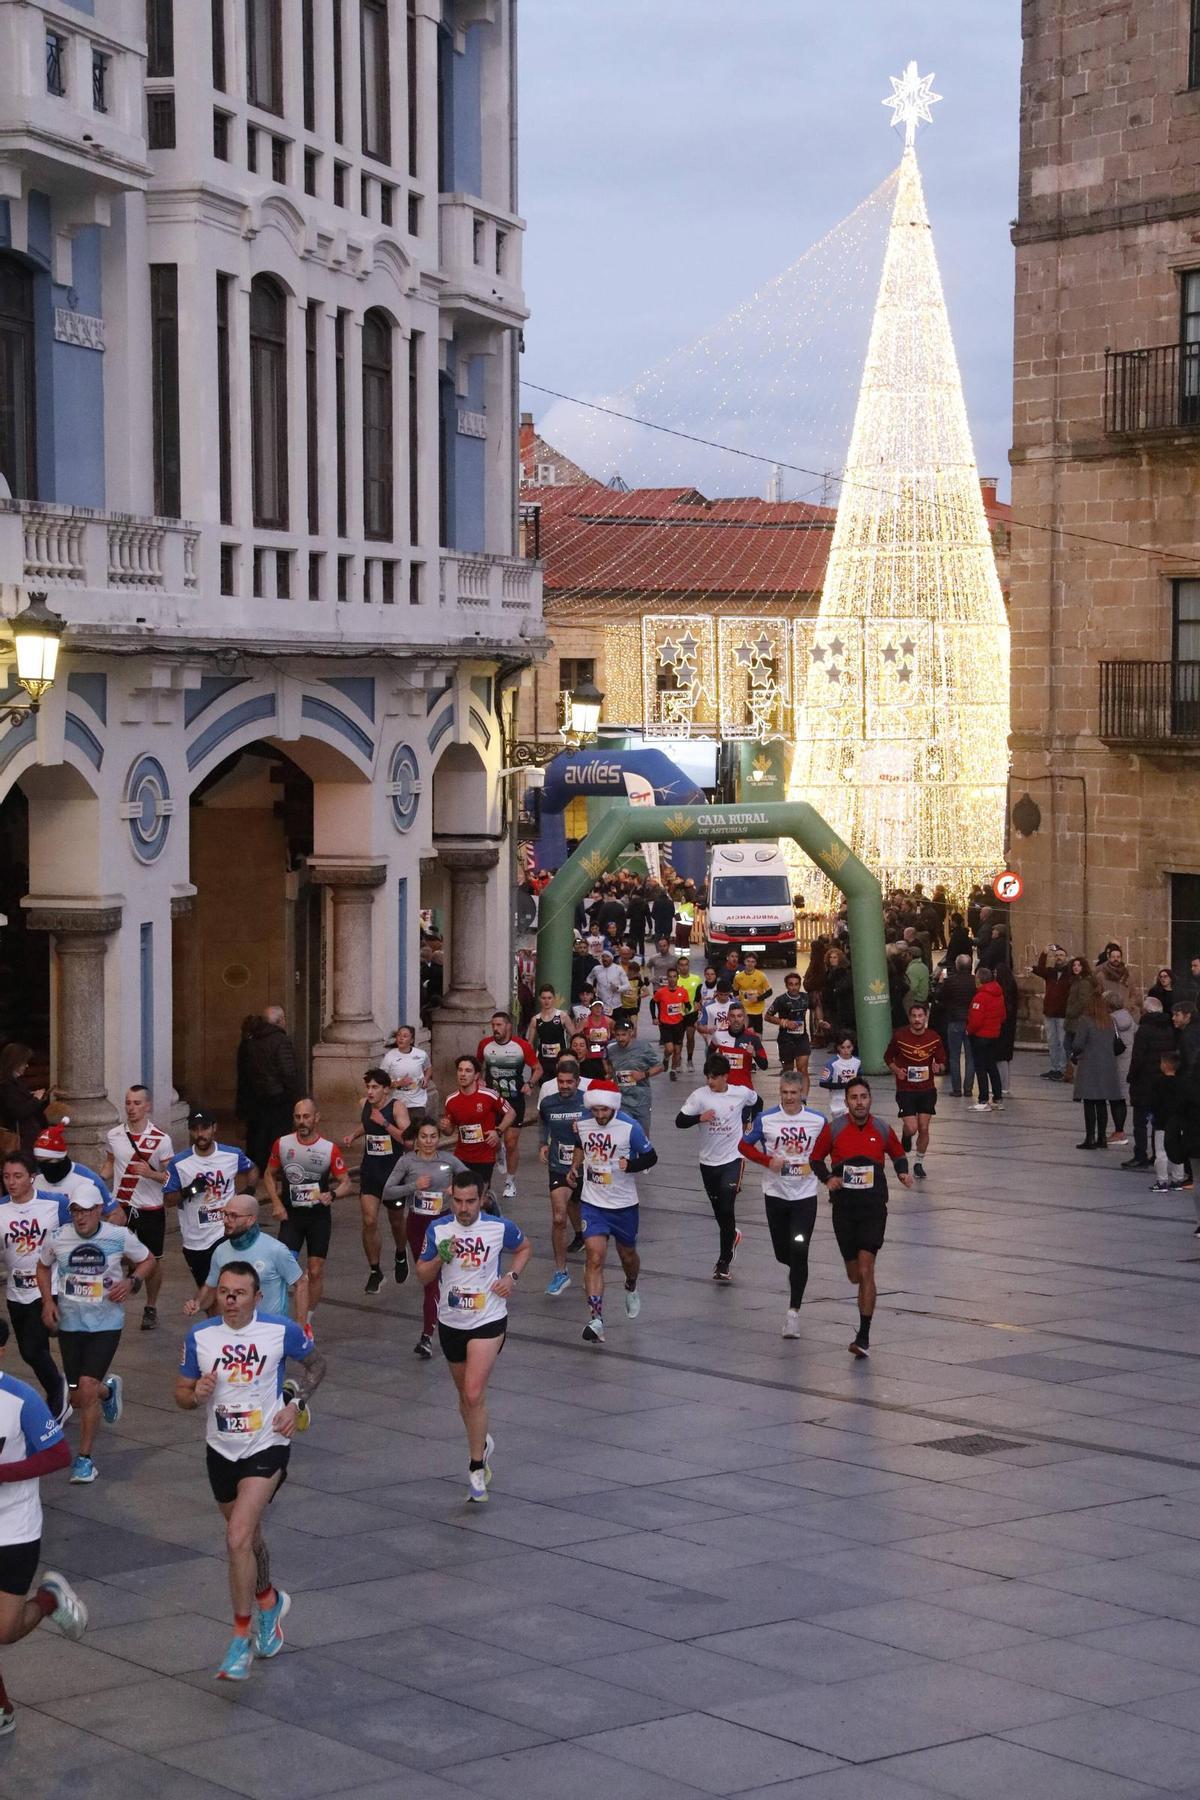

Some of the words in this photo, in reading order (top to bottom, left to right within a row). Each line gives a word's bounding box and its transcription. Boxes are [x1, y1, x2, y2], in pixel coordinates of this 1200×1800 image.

[565, 759, 621, 784] avilés
[697, 814, 727, 825] CAJA
[728, 813, 769, 824] RURAL
[711, 826, 749, 834] ASTURIAS
[717, 1011, 727, 1021] SS
[588, 1132, 612, 1149] SSA
[780, 1127, 807, 1142] SSA
[9, 1219, 41, 1238] SSA
[455, 1236, 485, 1254] SSA
[73, 1285, 94, 1296] 1052
[459, 1297, 474, 1308] 410
[221, 1343, 260, 1364] SSA
[225, 1417, 250, 1430] 1231
